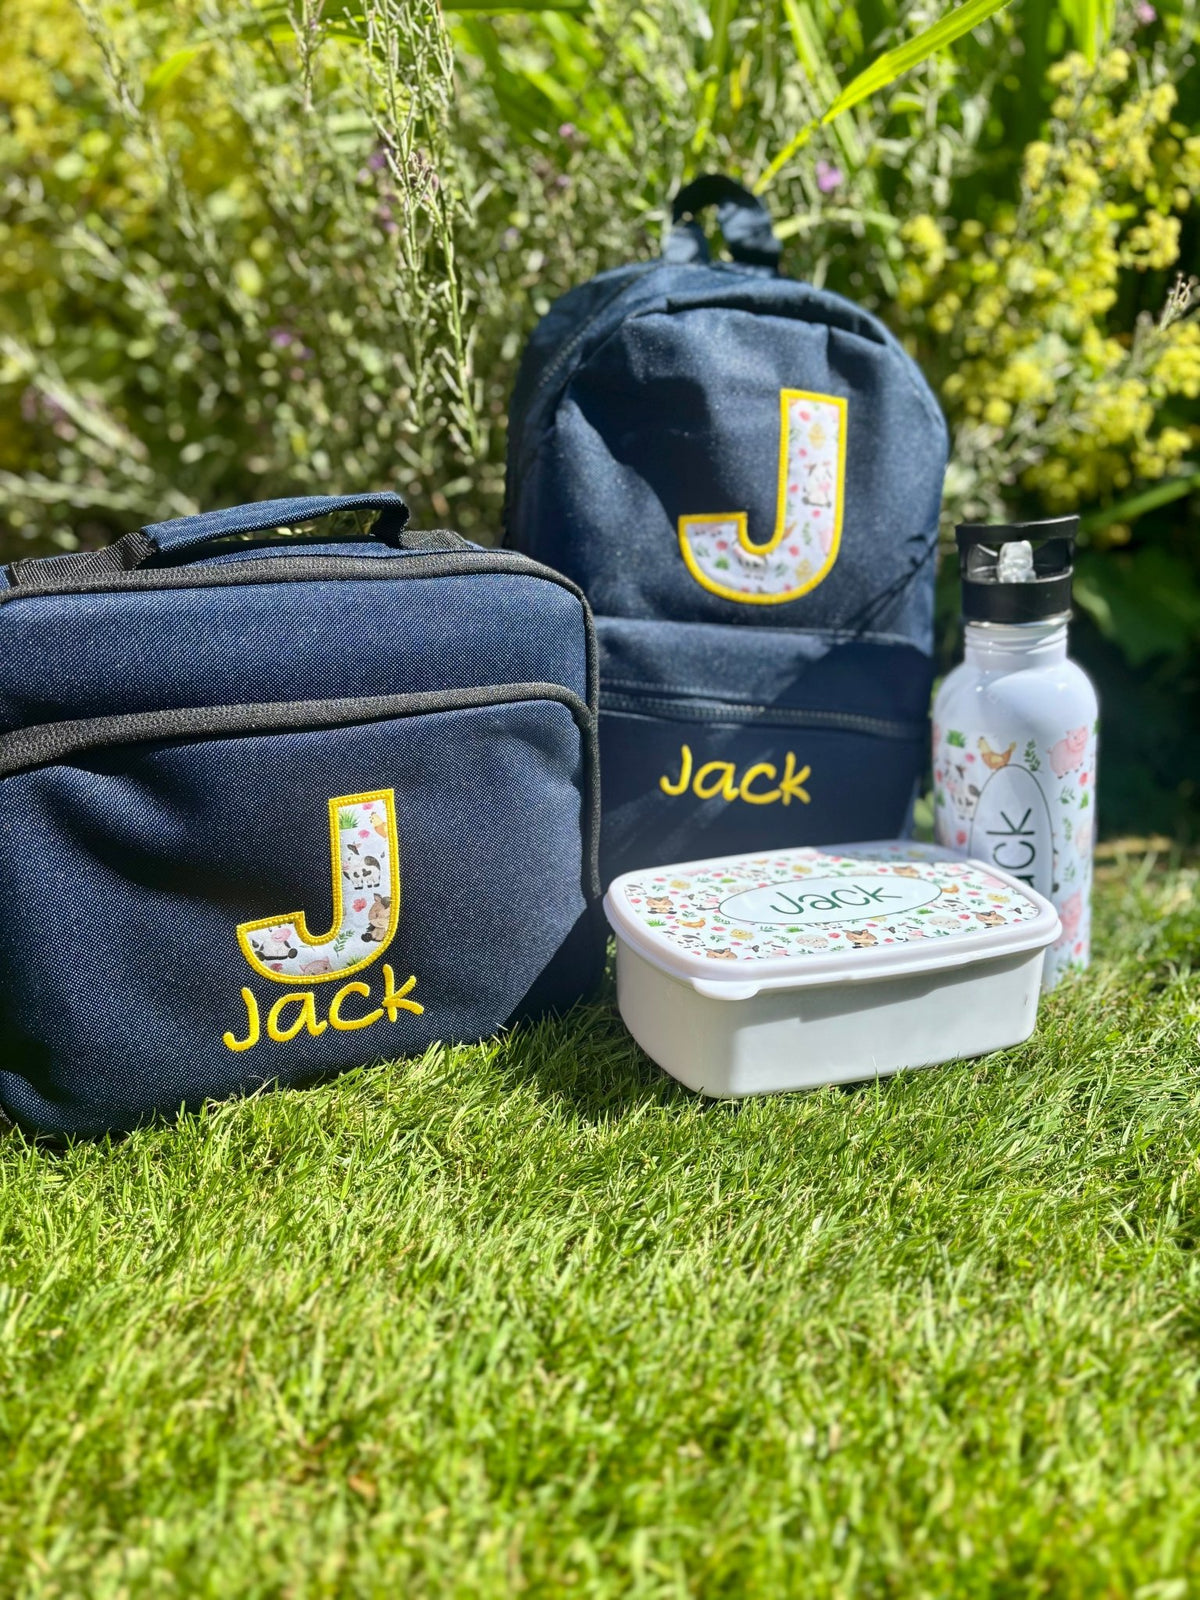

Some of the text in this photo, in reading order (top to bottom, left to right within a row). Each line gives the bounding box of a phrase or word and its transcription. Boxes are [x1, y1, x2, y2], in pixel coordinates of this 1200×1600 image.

[678, 387, 848, 605] J
[660, 744, 812, 806] Jack
[236, 788, 401, 985] J
[769, 884, 903, 916] Jack
[222, 963, 425, 1052] Jack
